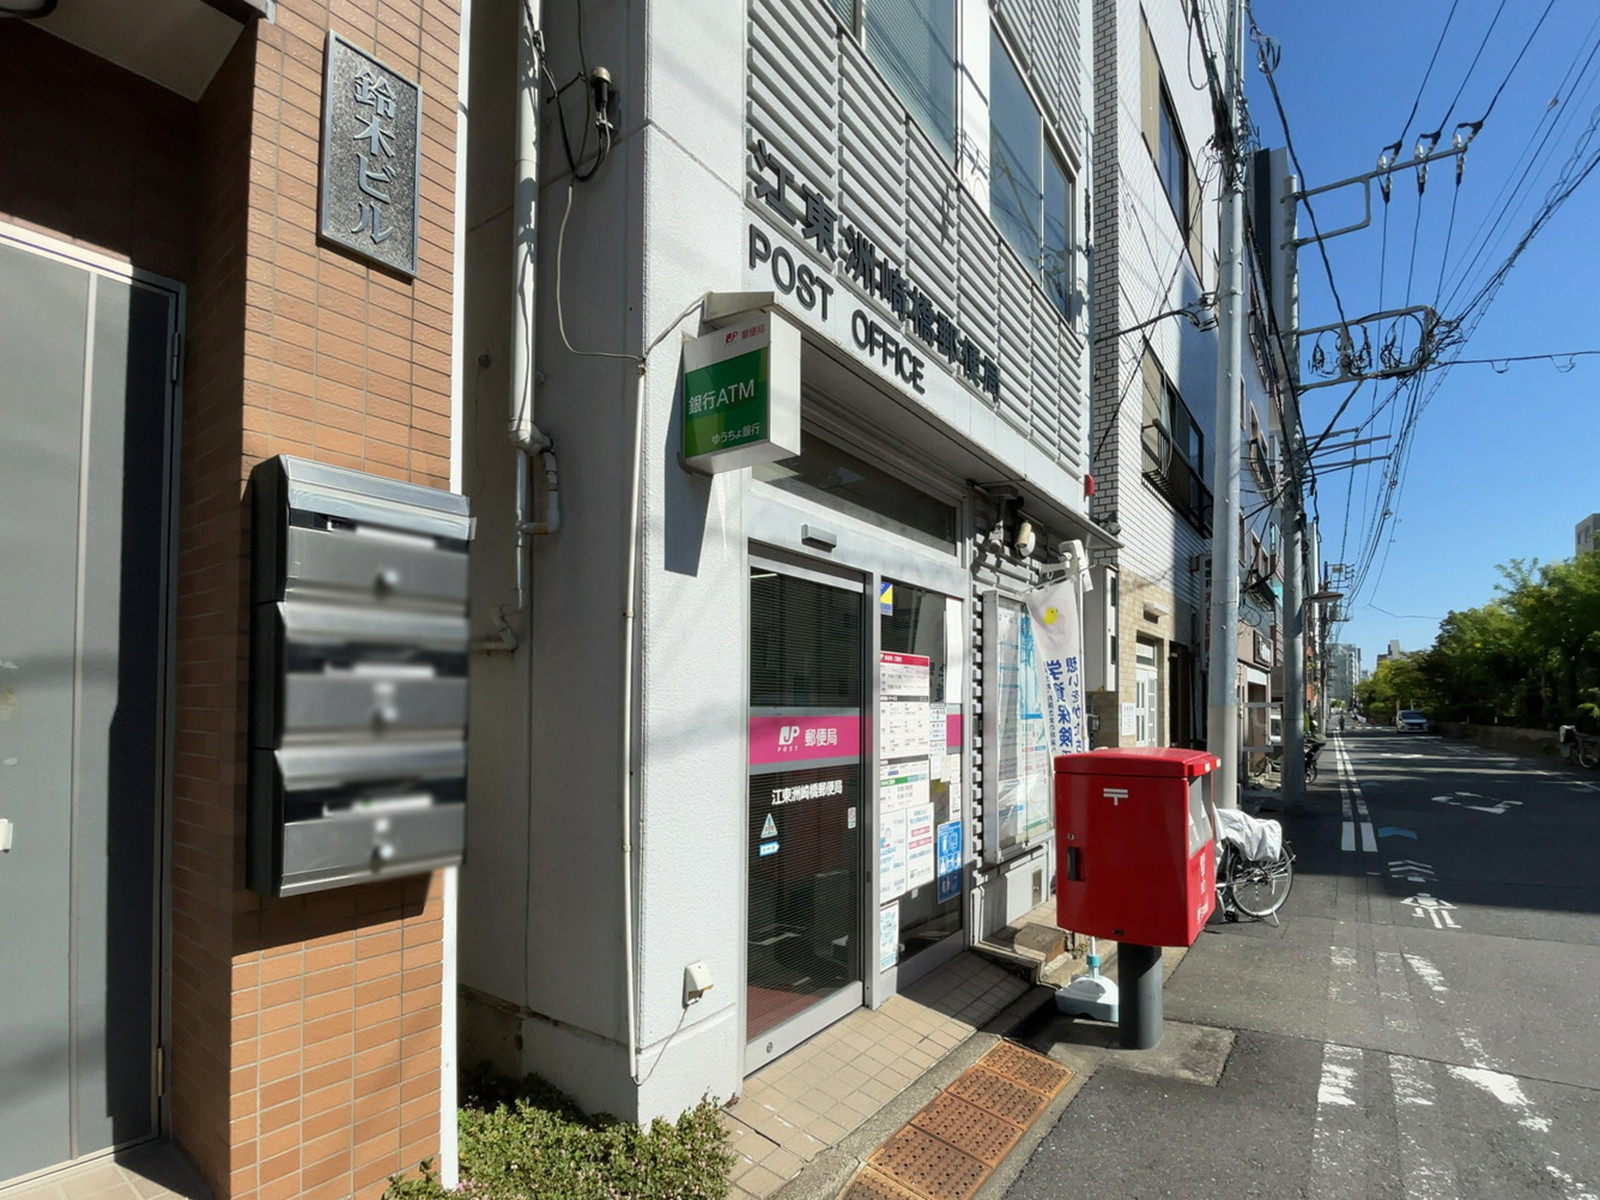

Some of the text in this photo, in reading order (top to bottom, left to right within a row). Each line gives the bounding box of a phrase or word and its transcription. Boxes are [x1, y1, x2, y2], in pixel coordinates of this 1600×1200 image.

[351, 66, 395, 246] 鈴木ビル
[749, 223, 926, 395] POST OFFICE
[688, 379, 755, 415] 銀行ATM
[712, 422, 761, 446] ゆうちょ銀行
[804, 728, 837, 747] 郵便局
